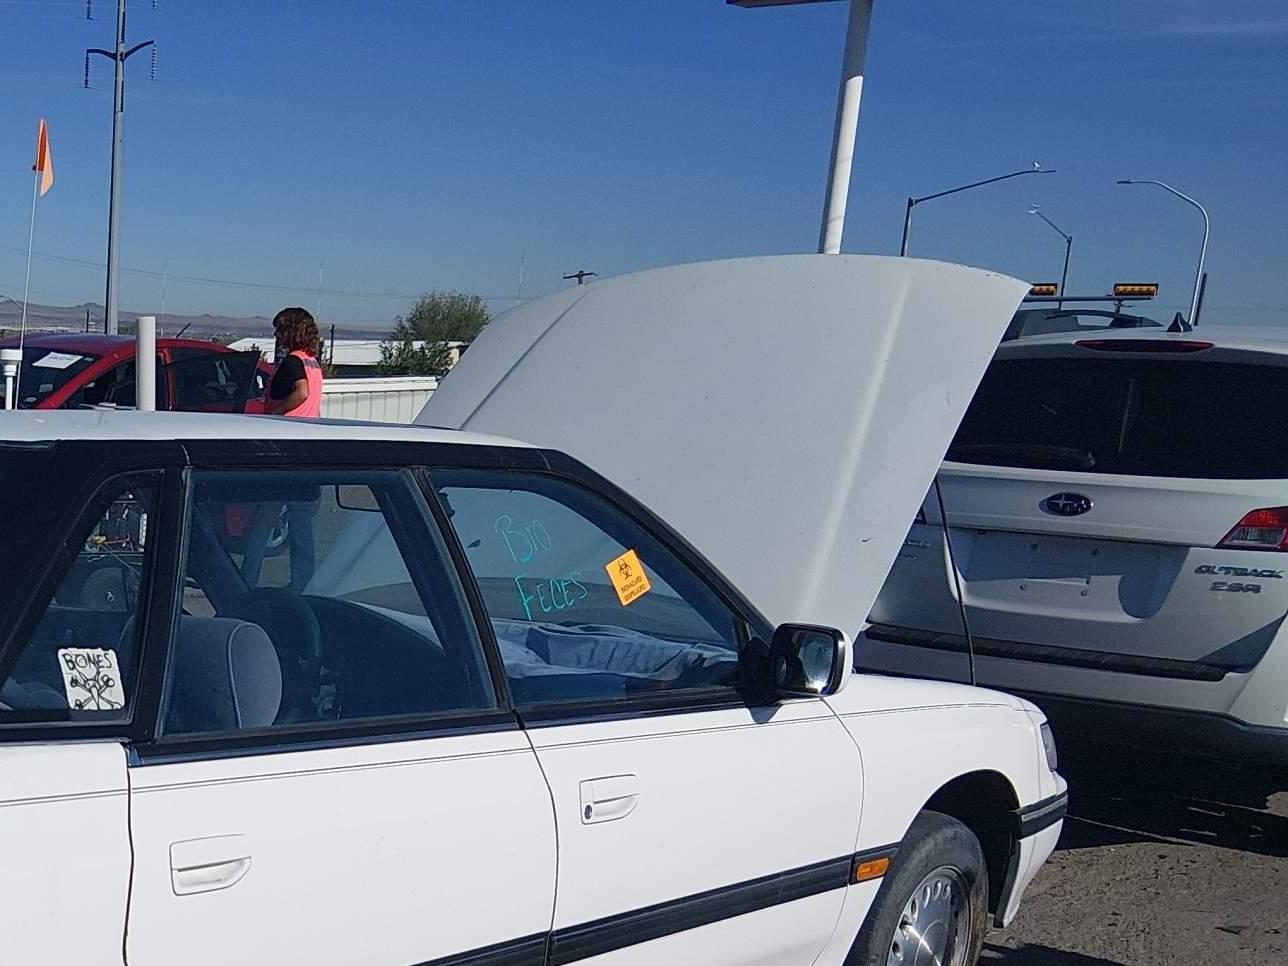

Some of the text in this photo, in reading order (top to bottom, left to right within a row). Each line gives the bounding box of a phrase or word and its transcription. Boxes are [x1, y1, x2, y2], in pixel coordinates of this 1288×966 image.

[1194, 565, 1285, 579] OUTBACK
[514, 571, 588, 621] FECES
[62, 652, 112, 671] BONES
